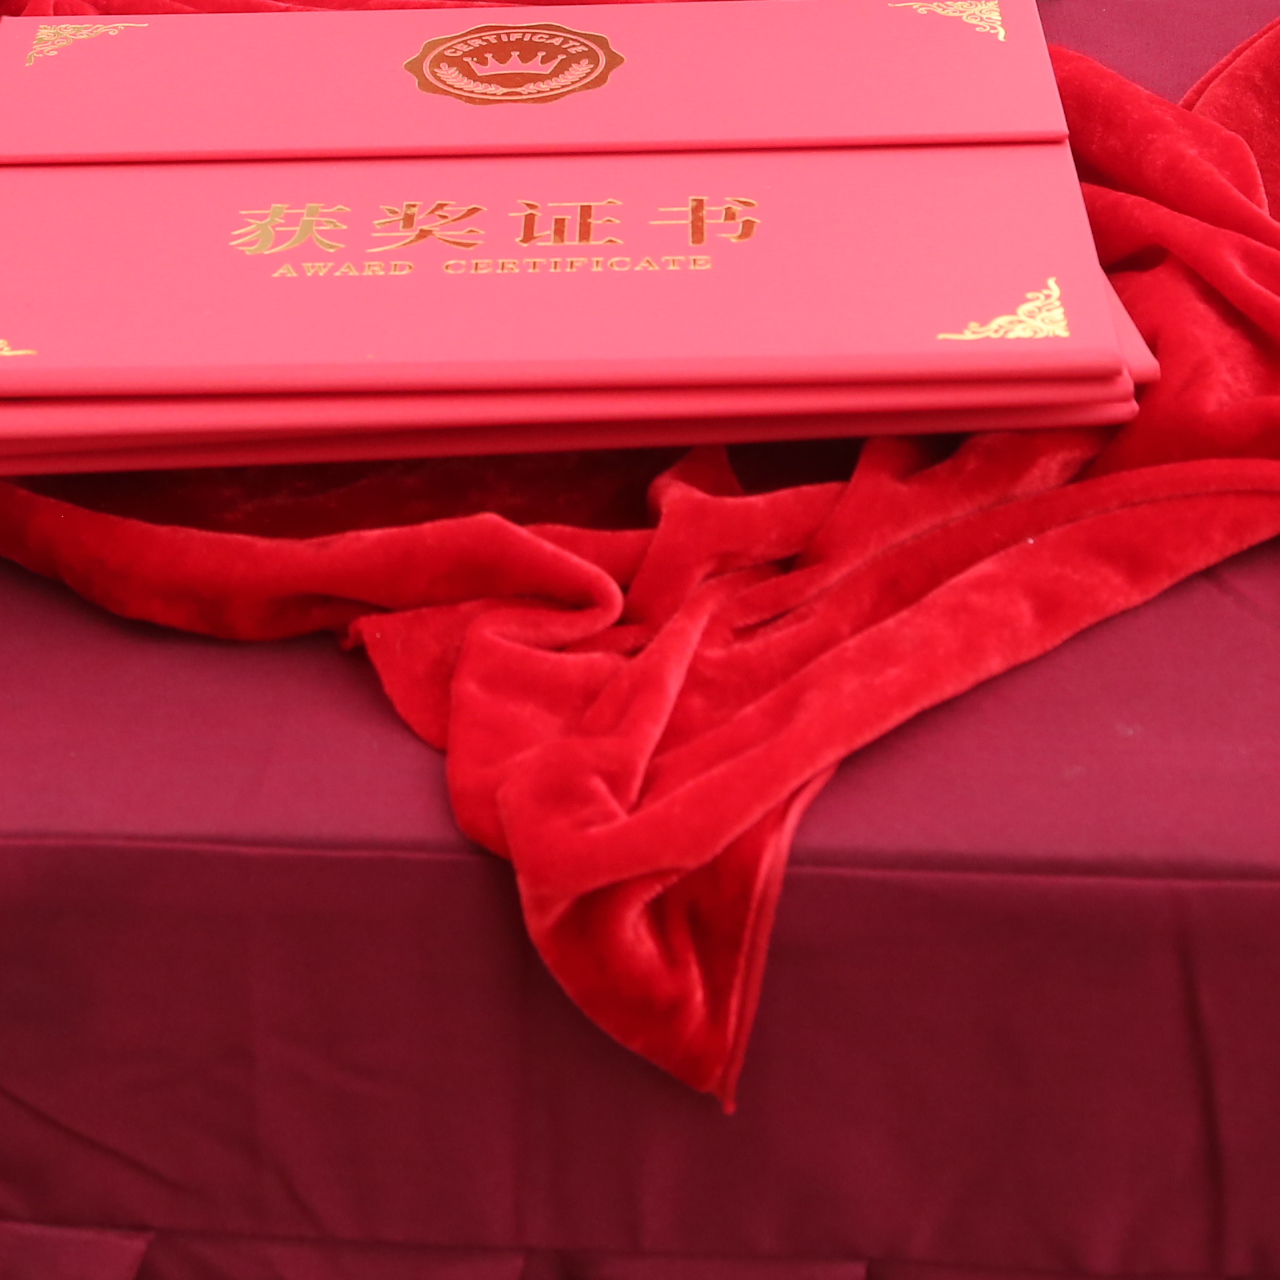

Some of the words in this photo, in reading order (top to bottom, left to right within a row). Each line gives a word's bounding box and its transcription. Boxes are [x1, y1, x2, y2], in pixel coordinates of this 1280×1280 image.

[444, 33, 588, 57] CERTIFICATE
[230, 196, 762, 255] 获奖证书
[271, 261, 415, 278] AWARD
[442, 254, 714, 275] CERTIFICATE
